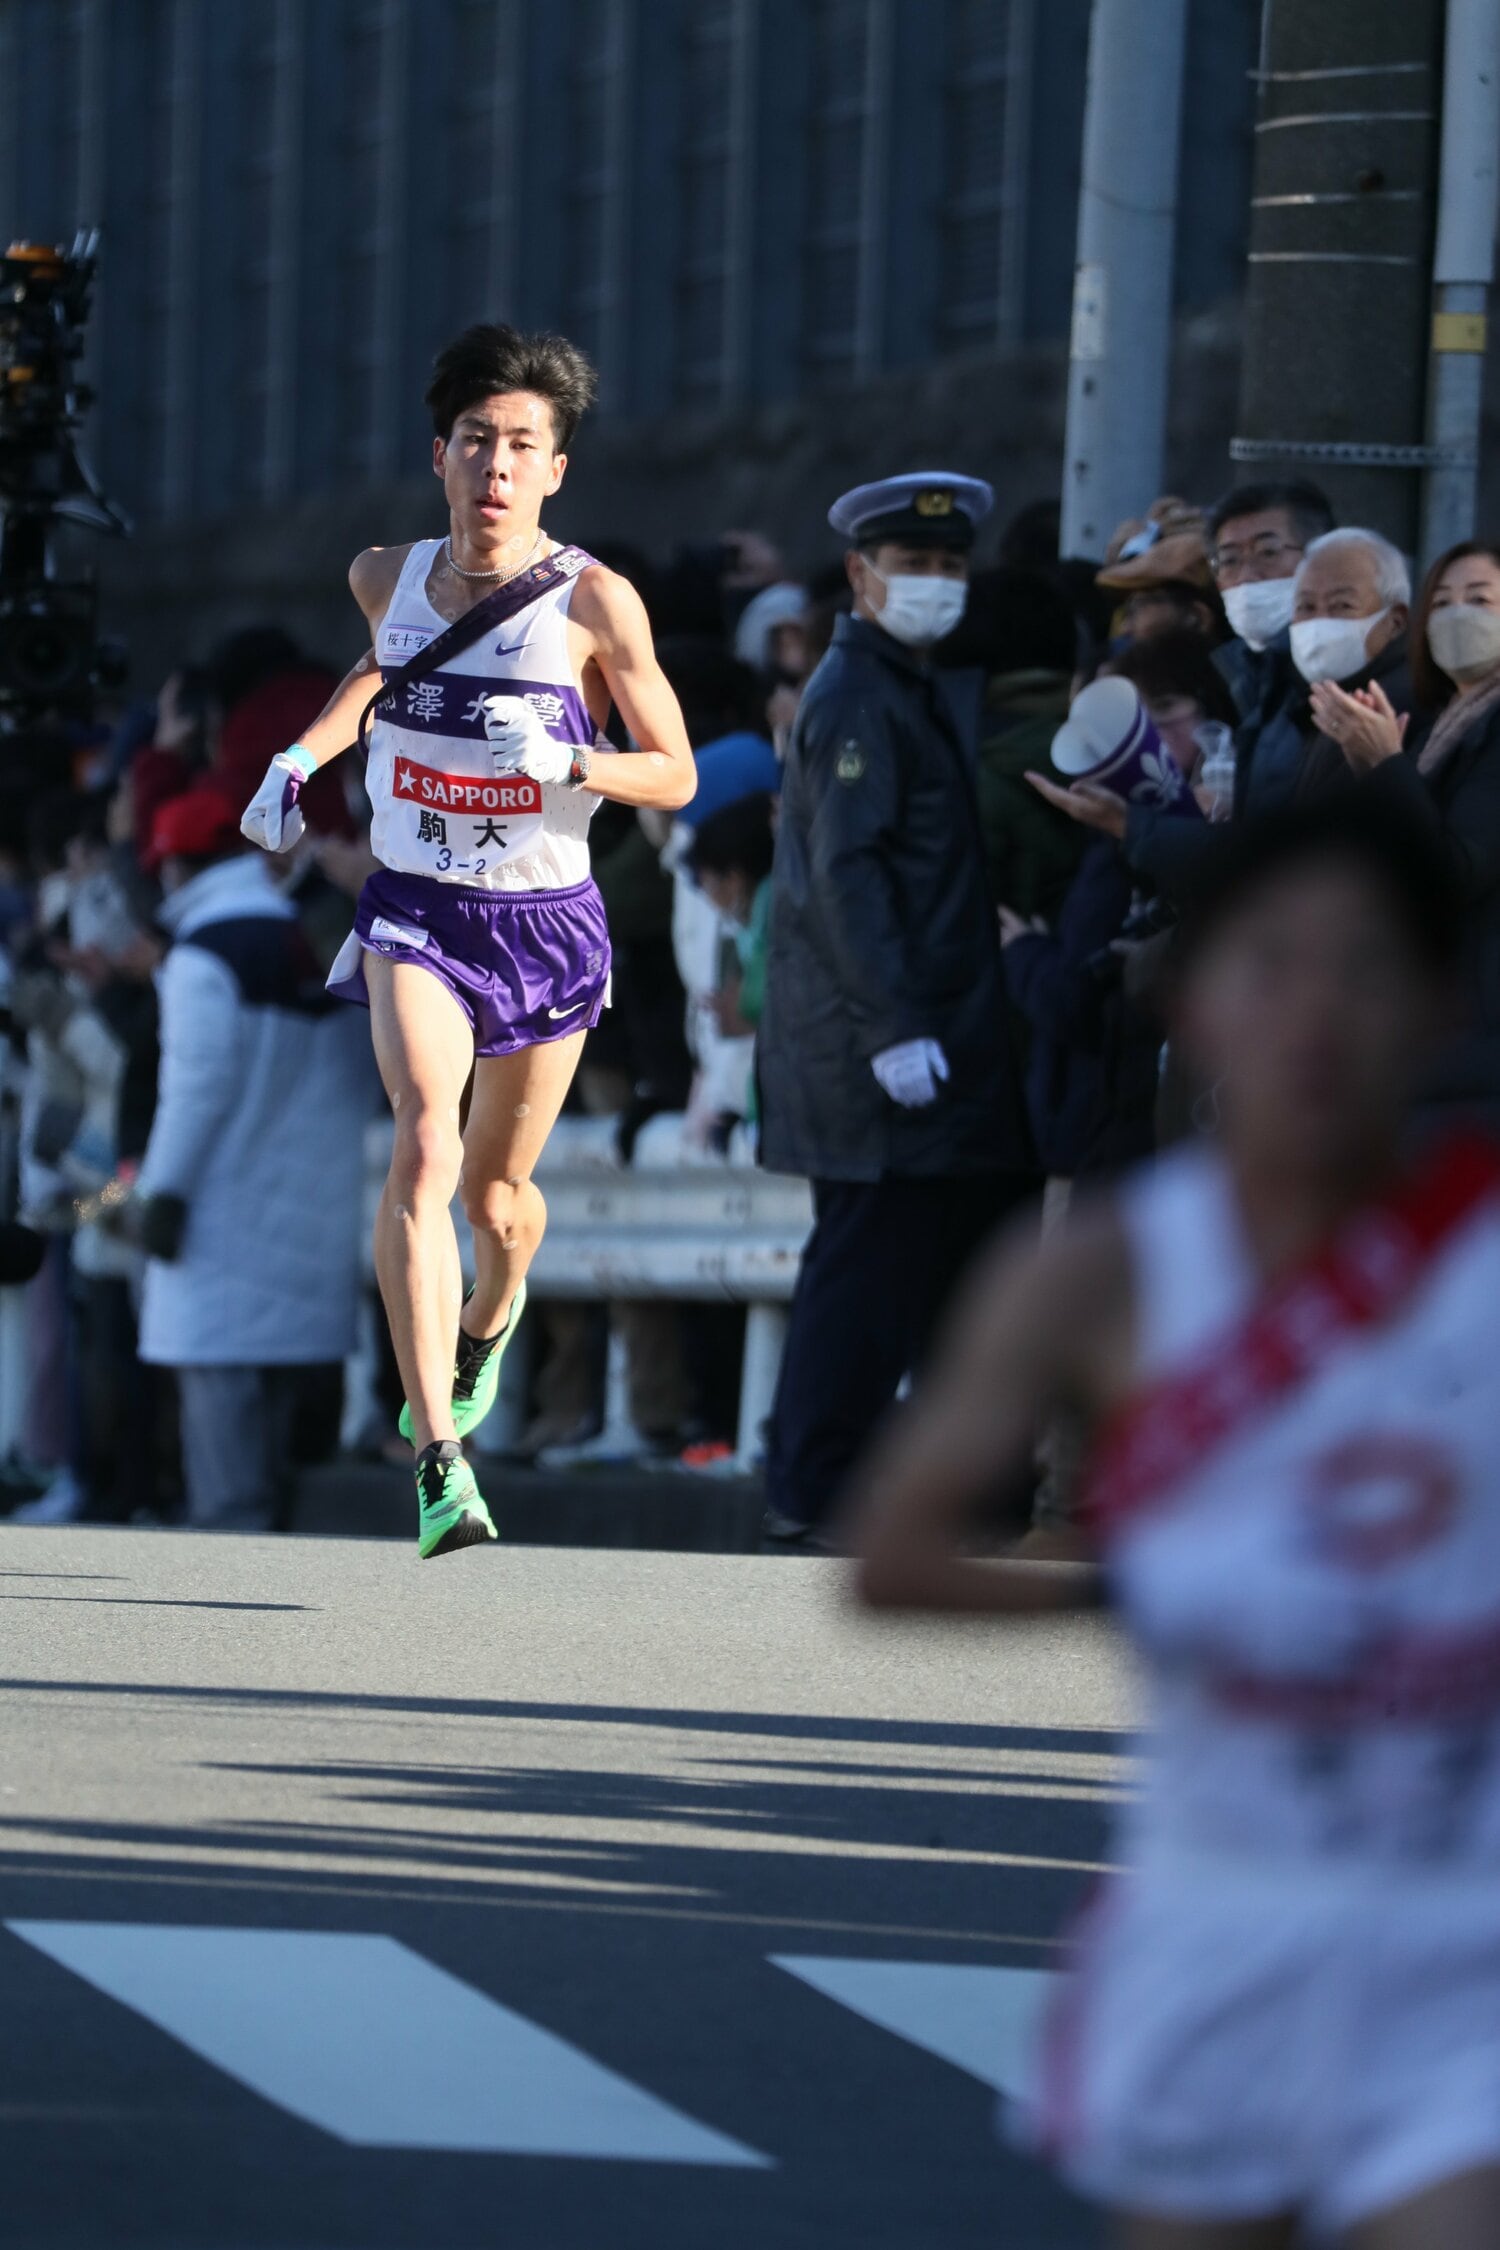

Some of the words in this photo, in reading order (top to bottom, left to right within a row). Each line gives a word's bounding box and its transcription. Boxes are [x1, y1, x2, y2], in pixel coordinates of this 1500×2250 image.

[387, 632, 428, 648] 桜十字
[421, 777, 535, 808] SAPPORO
[416, 809, 508, 849] 駒大
